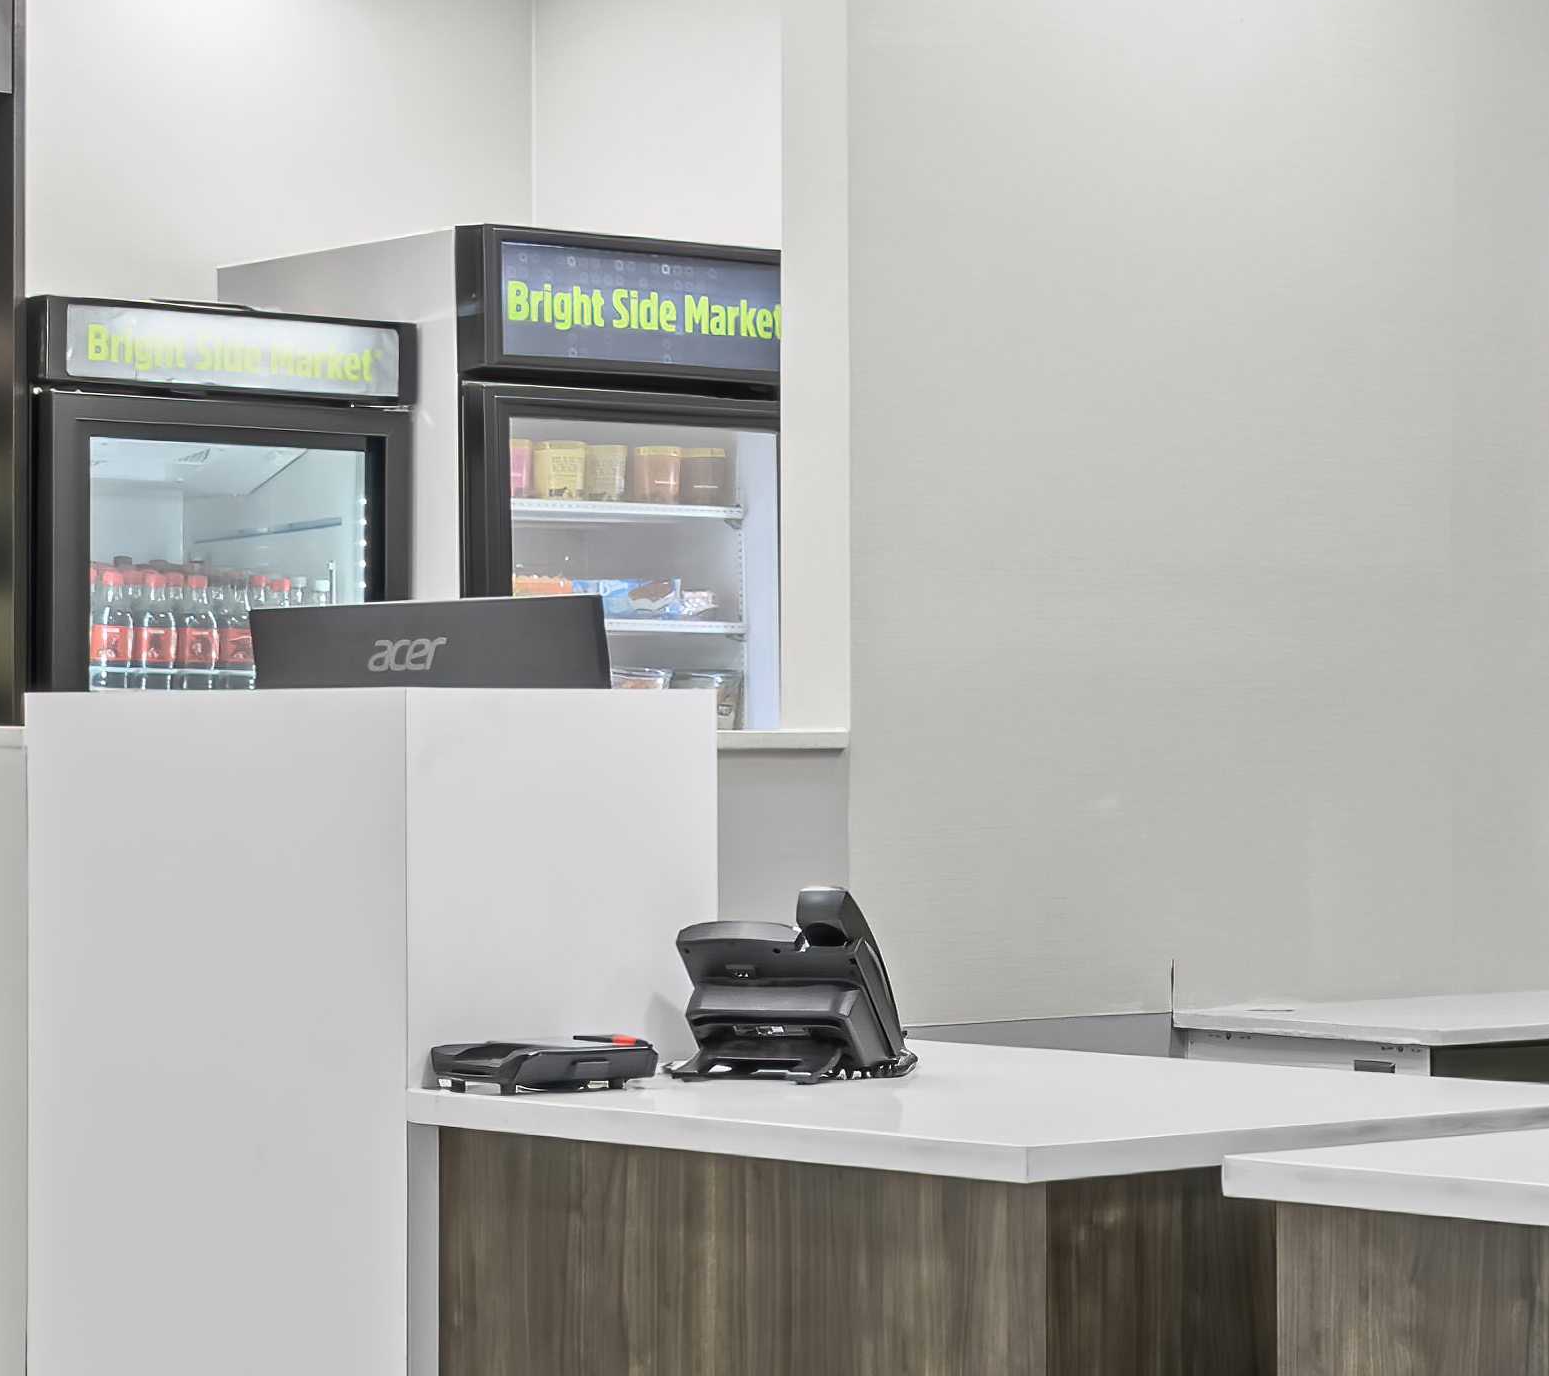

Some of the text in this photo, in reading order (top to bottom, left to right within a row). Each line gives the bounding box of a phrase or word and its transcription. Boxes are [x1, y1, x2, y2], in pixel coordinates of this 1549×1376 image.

[507, 280, 605, 331] Bright
[612, 288, 677, 333] Side
[87, 323, 186, 371] Bright
[194, 332, 259, 373] Side
[368, 636, 447, 672] acer
